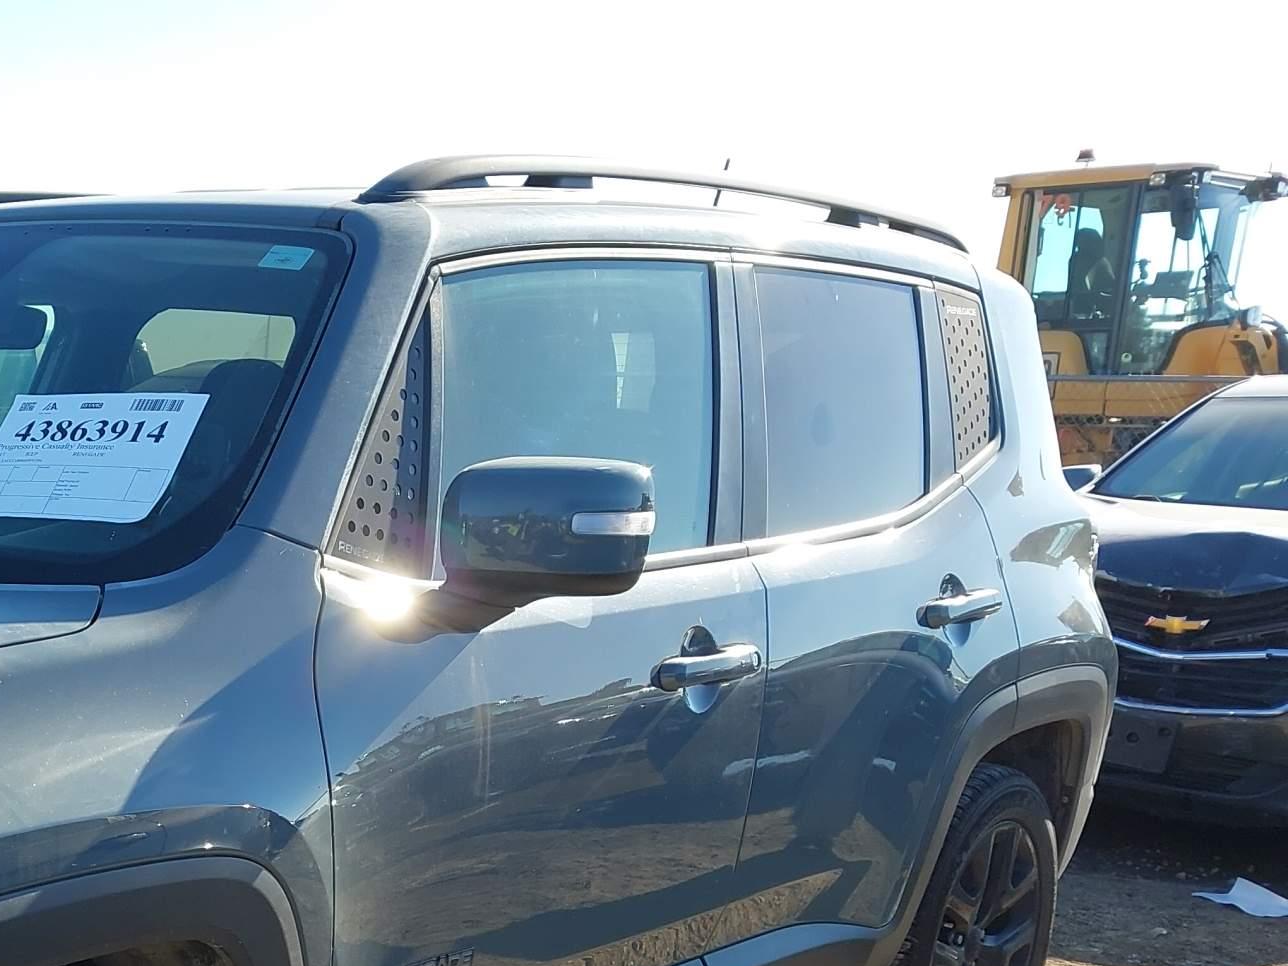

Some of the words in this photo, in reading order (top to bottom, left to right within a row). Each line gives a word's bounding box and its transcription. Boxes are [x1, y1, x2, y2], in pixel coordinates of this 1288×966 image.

[14, 419, 169, 443] 43863914
[41, 442, 73, 451] Casualty
[76, 443, 115, 451] Insurance
